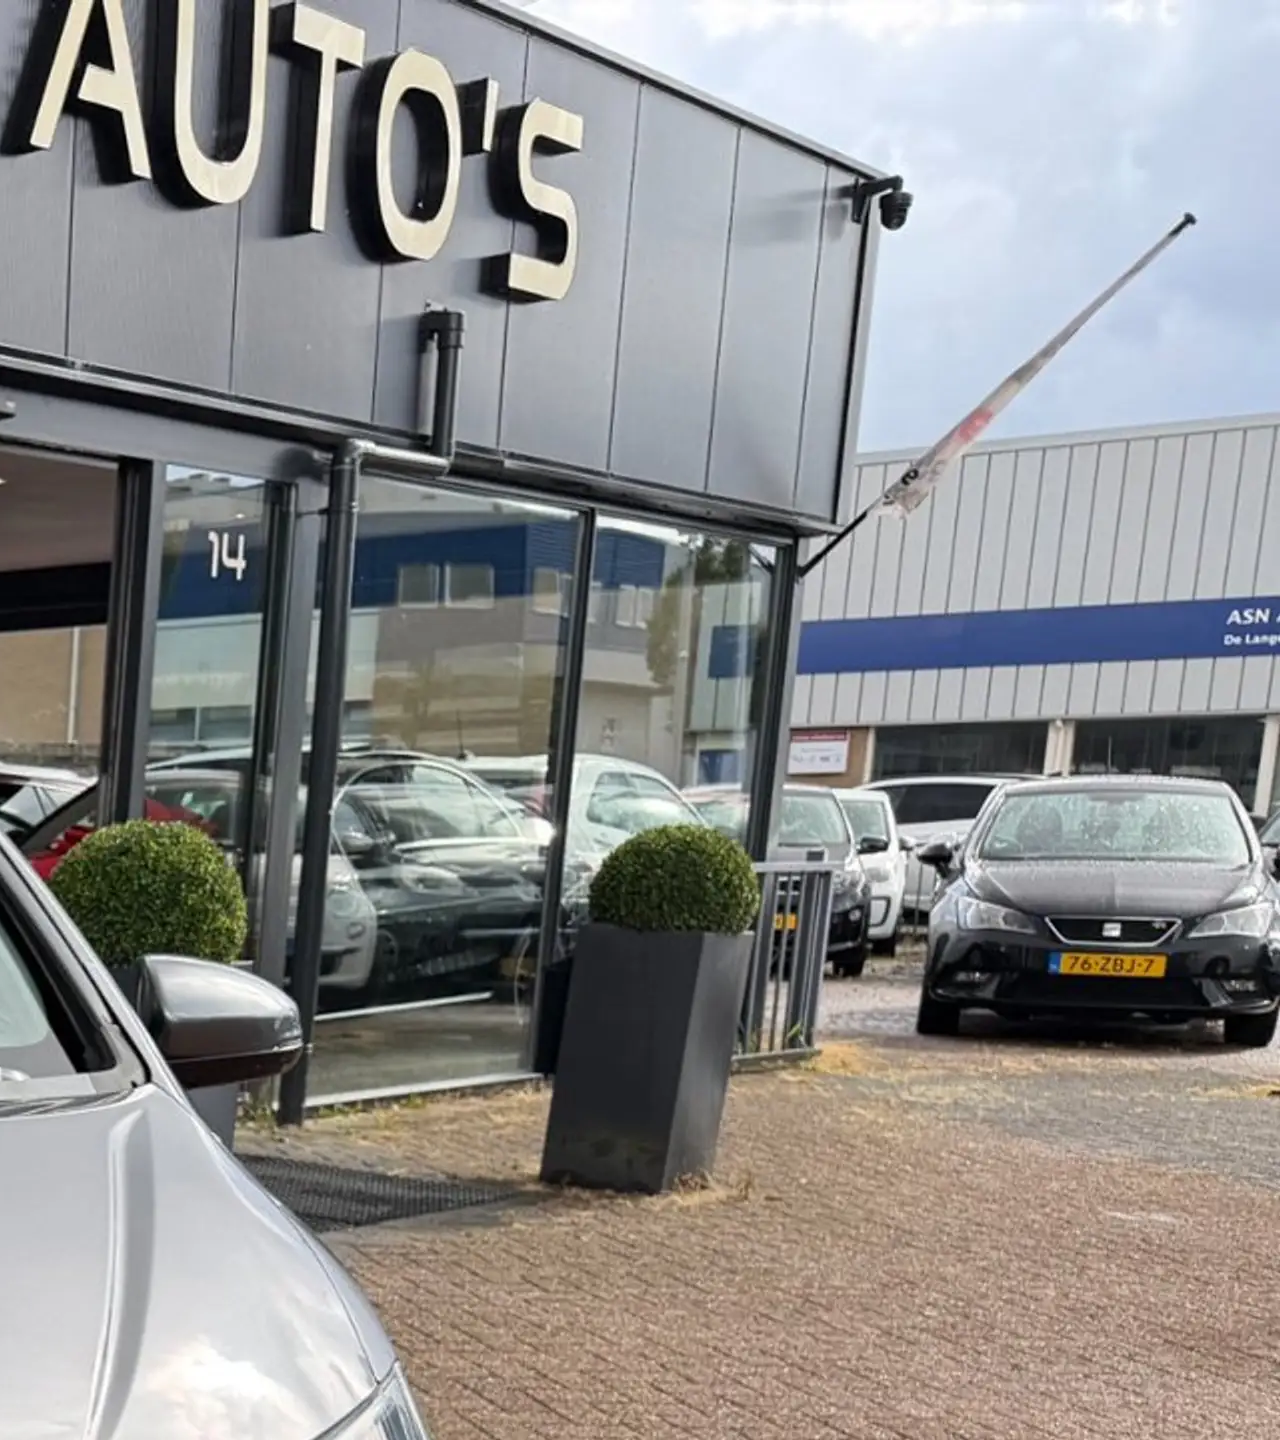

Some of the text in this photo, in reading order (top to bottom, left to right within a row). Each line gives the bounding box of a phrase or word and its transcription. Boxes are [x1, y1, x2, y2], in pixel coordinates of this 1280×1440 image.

[30, 0, 583, 301] AUTO'S
[208, 531, 247, 580] 14
[1226, 608, 1271, 625] ASN
[1224, 634, 1243, 645] De
[1068, 956, 1156, 973] 76-ZBJ-7
